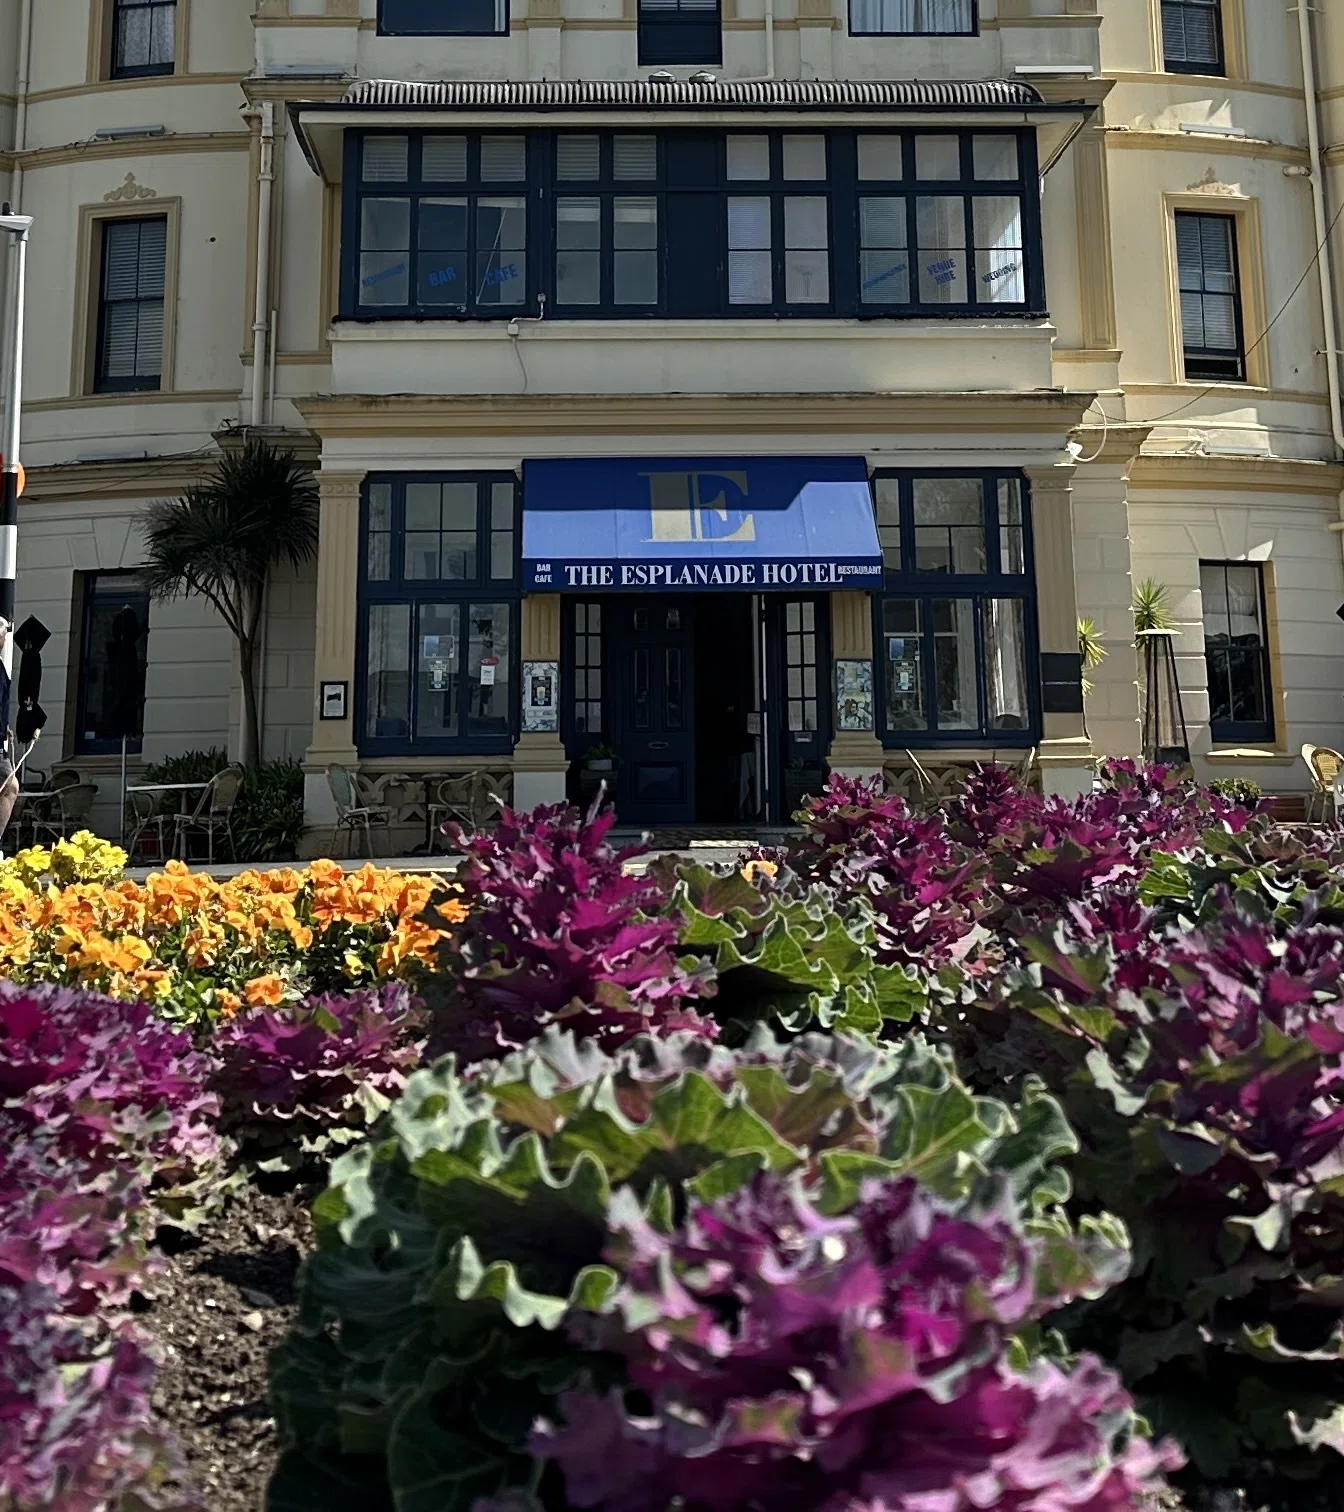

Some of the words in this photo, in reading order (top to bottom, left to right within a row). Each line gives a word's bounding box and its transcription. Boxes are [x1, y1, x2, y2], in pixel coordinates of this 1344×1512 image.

[485, 263, 519, 286] CAFE
[637, 470, 756, 543] E
[564, 565, 614, 586] THE
[620, 564, 756, 585] ESPLANADE
[762, 563, 843, 584] HOTEL
